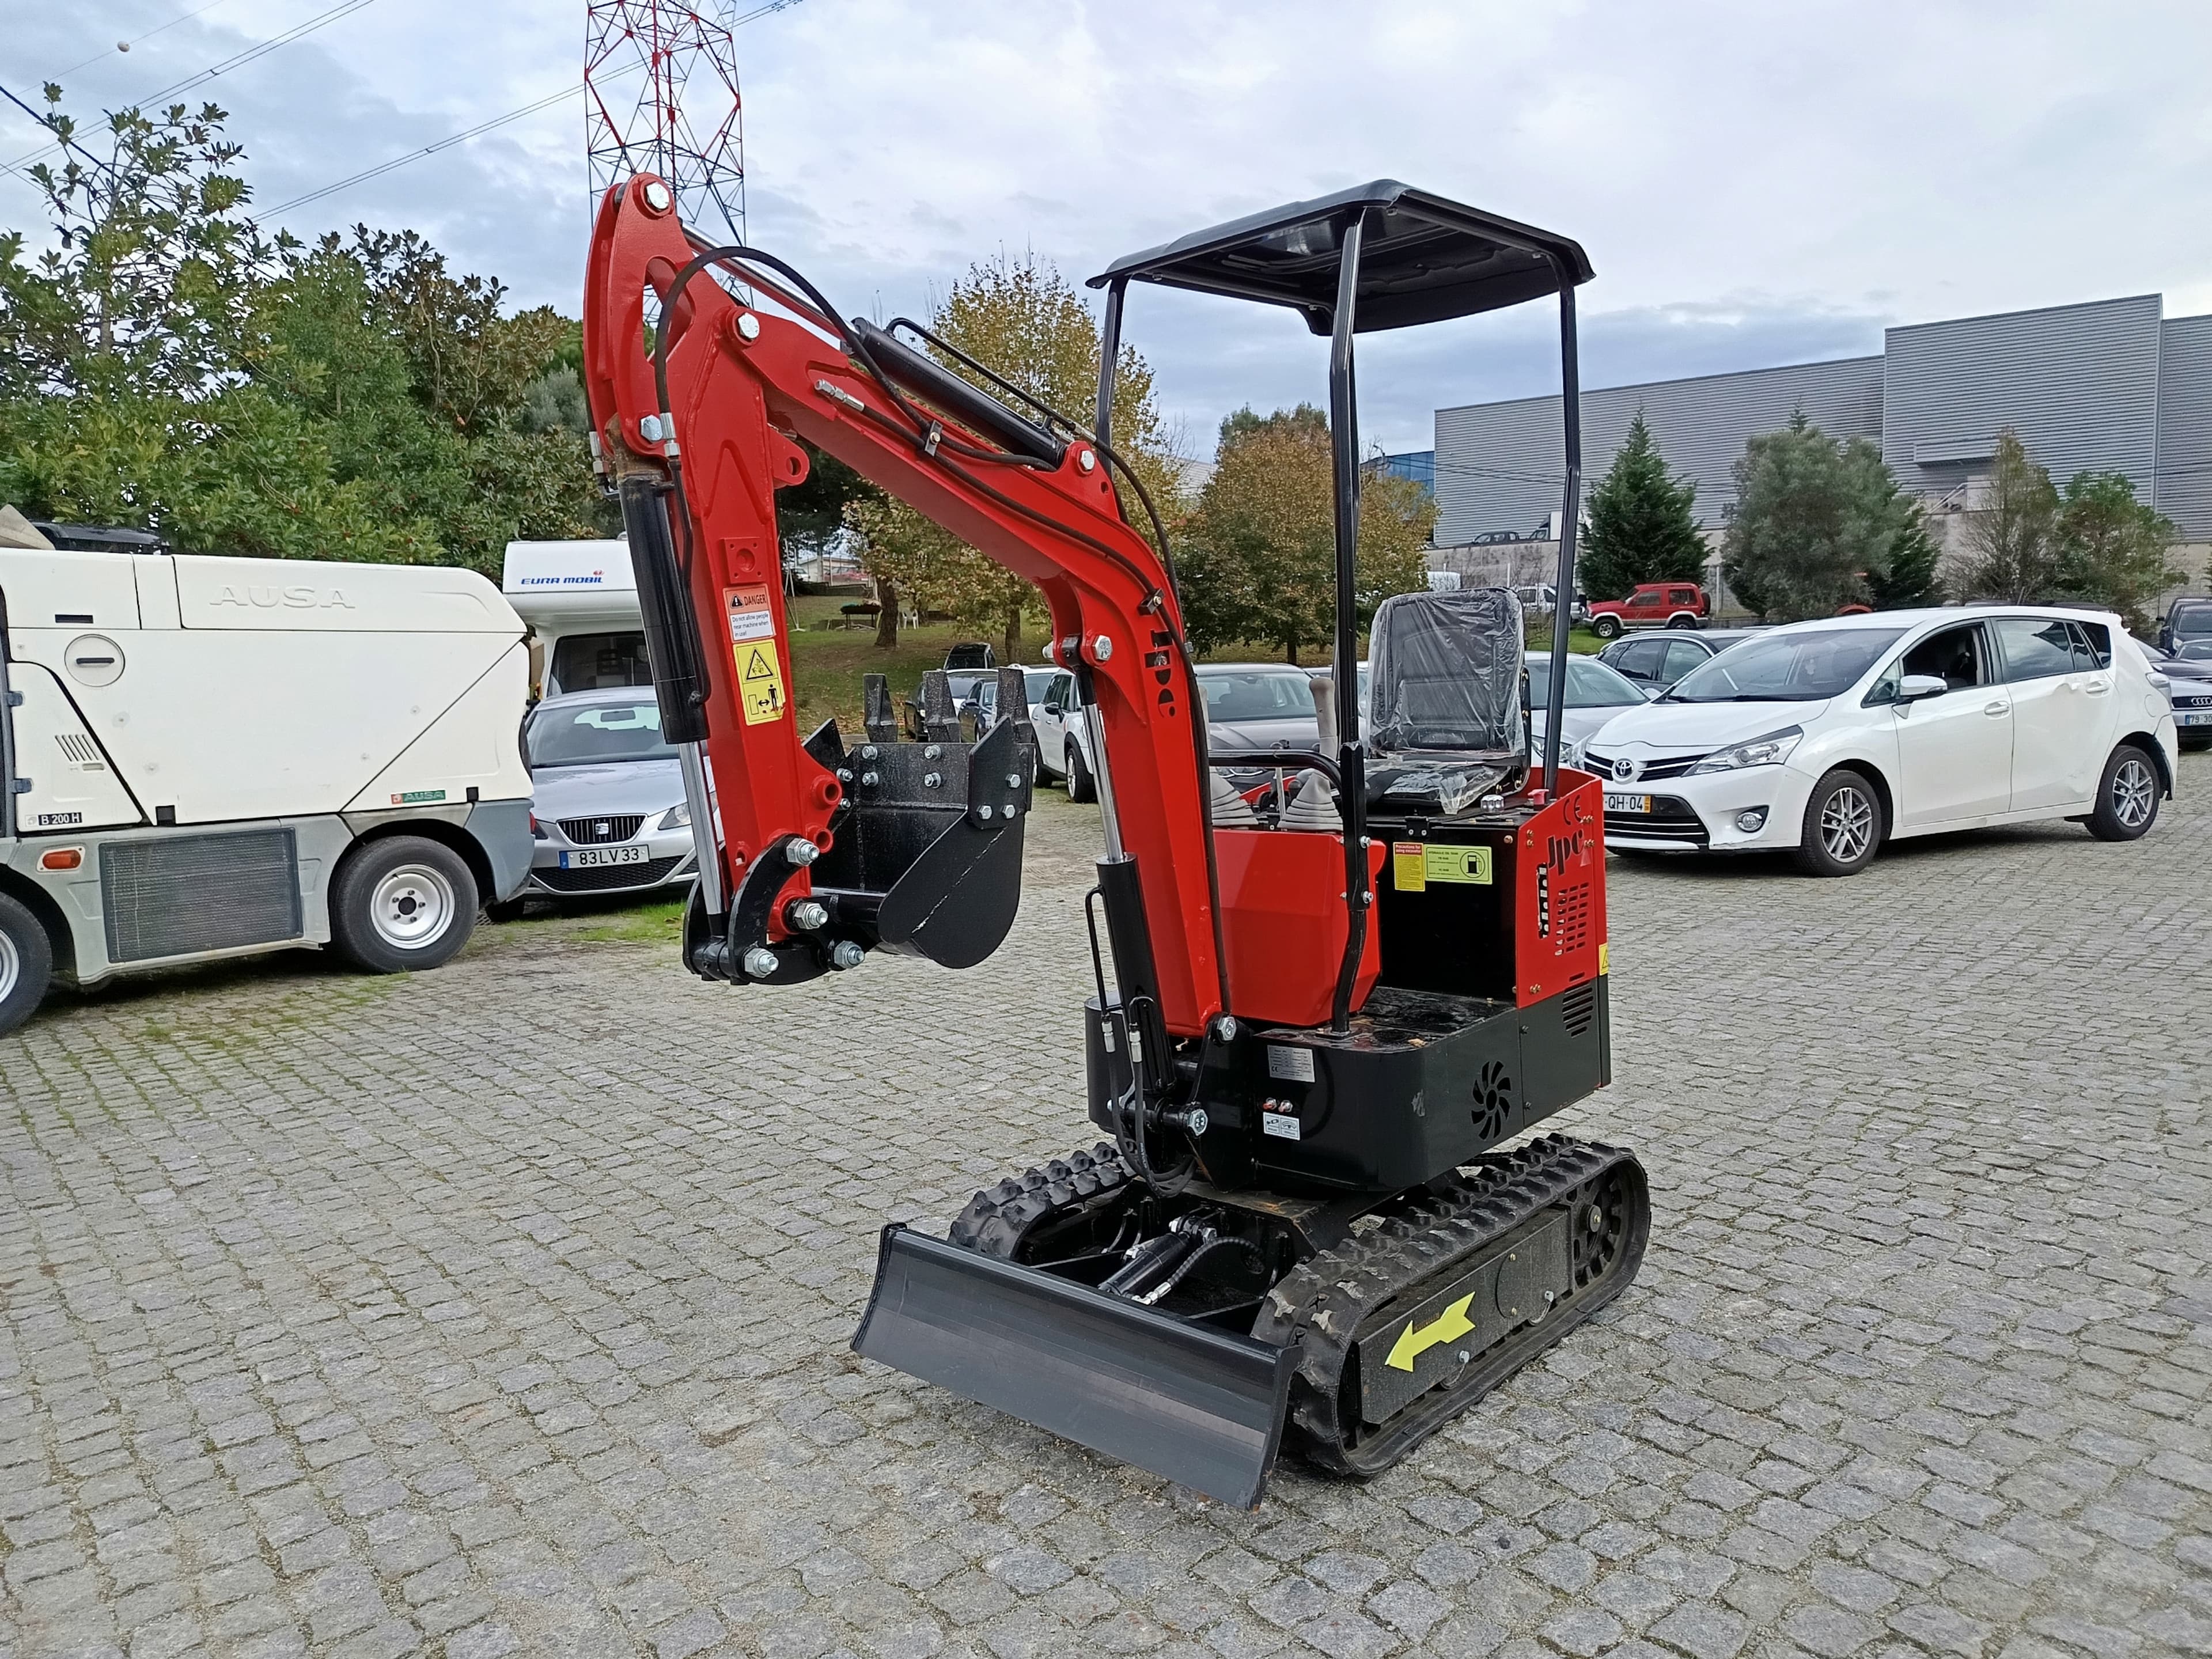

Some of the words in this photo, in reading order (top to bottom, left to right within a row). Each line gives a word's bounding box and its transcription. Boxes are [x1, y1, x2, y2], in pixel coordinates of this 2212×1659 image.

[209, 584, 356, 609] AUSA
[744, 594, 767, 606] DANGER
[756, 612, 768, 620] people
[404, 791, 445, 802] AUSA
[41, 816, 49, 825] B
[51, 813, 70, 824] 200
[71, 812, 80, 823] H
